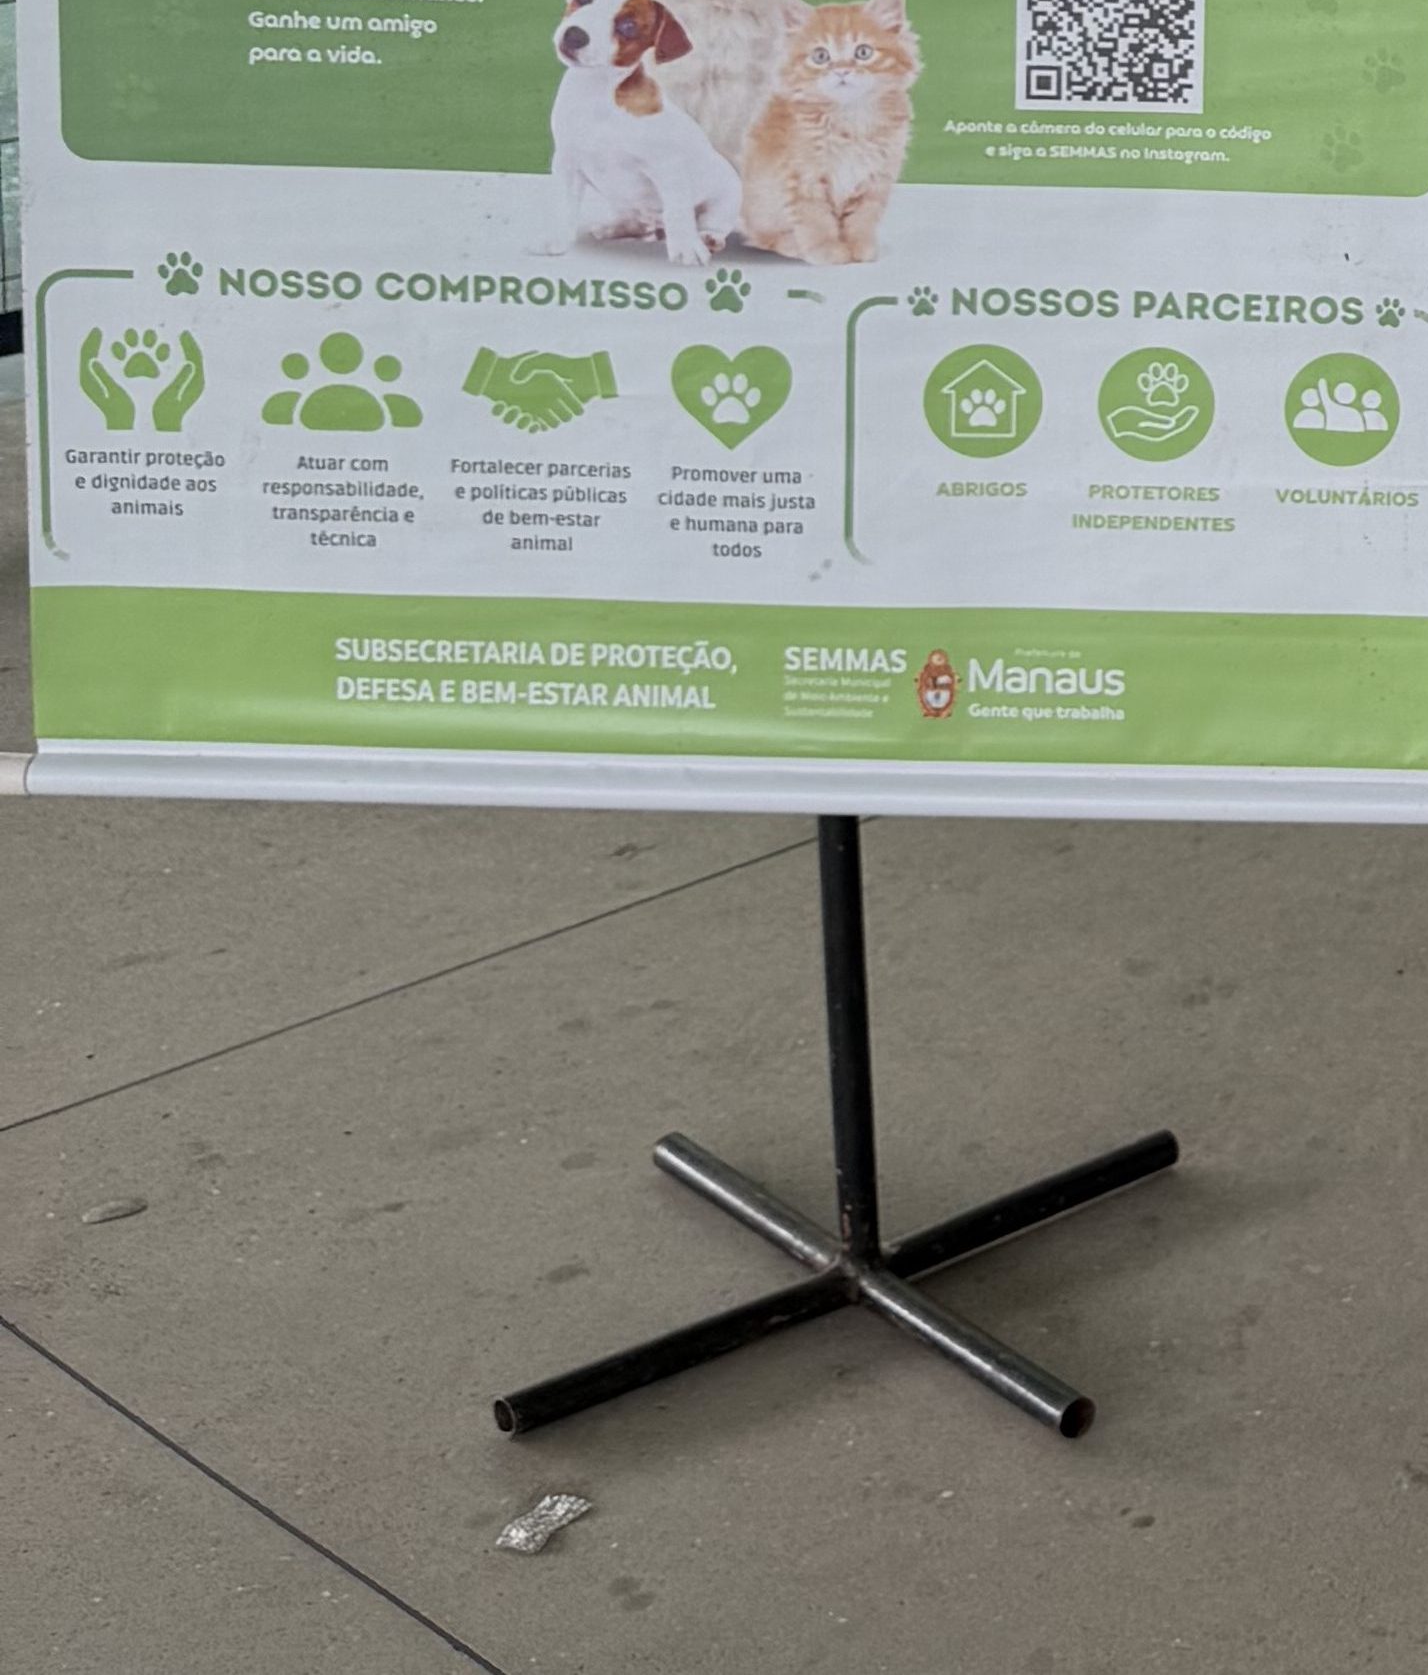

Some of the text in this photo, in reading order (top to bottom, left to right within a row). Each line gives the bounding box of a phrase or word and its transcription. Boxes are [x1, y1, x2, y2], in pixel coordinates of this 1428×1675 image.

[249, 11, 437, 38] Ganhe um amigo
[249, 45, 381, 64] para a vida.
[219, 268, 688, 311] NOSSO COMPROMISSO
[952, 287, 1363, 325] NOSSOS PARCEIROS
[65, 449, 225, 470] Garantir proteção
[297, 456, 388, 472] Atuar com
[75, 474, 216, 493] e dignidade aos
[263, 481, 424, 500] responsabilidade,
[936, 481, 1027, 497] ABRIGOS
[1089, 484, 1220, 501] PROTETORES
[1276, 486, 1419, 508] VOLUNTÁRIOS
[111, 500, 184, 516] animais
[273, 506, 414, 525] transparência e
[1073, 514, 1235, 532] INDEPENDENTES
[311, 531, 376, 547] técnica
[336, 638, 737, 675] SUBSECRETARIA DE PROTEÇÃO,
[784, 646, 906, 673] SEMMAS
[968, 658, 1125, 696] Manaus
[336, 676, 716, 709] DEFESA E BEM-ESTAR ANIMAL
[968, 703, 1125, 721] Gente que trabalha
